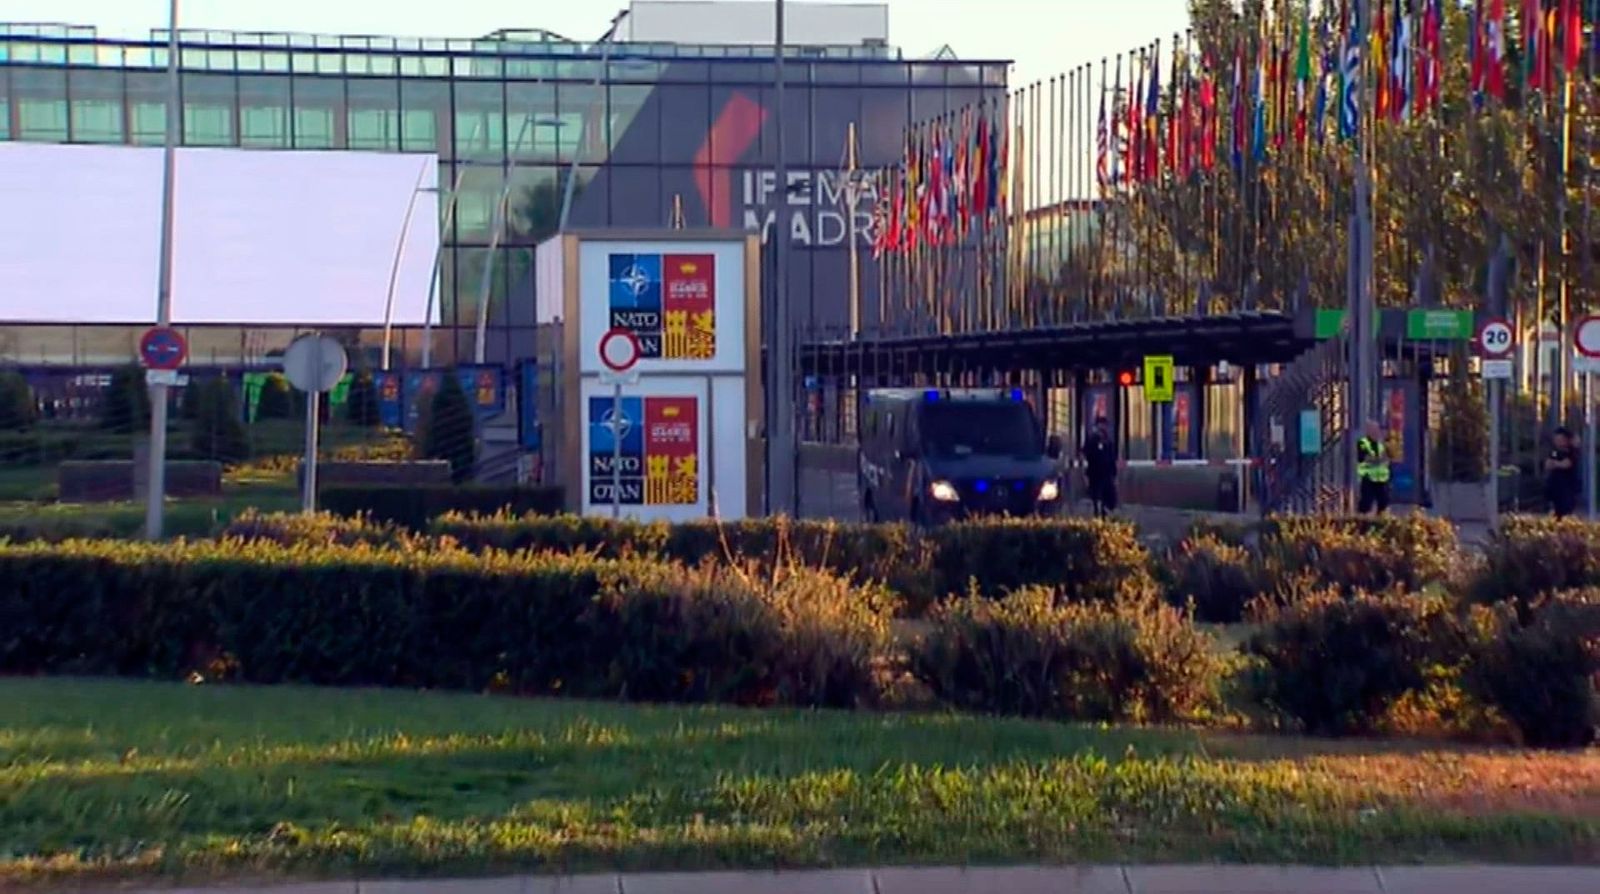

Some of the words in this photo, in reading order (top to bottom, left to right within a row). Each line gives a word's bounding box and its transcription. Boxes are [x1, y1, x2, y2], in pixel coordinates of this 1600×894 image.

[744, 171, 878, 205] IFEMA
[613, 312, 658, 327] NATO
[1486, 330, 1508, 344] 20
[593, 456, 640, 471] NATO
[593, 484, 640, 499] OTAN
